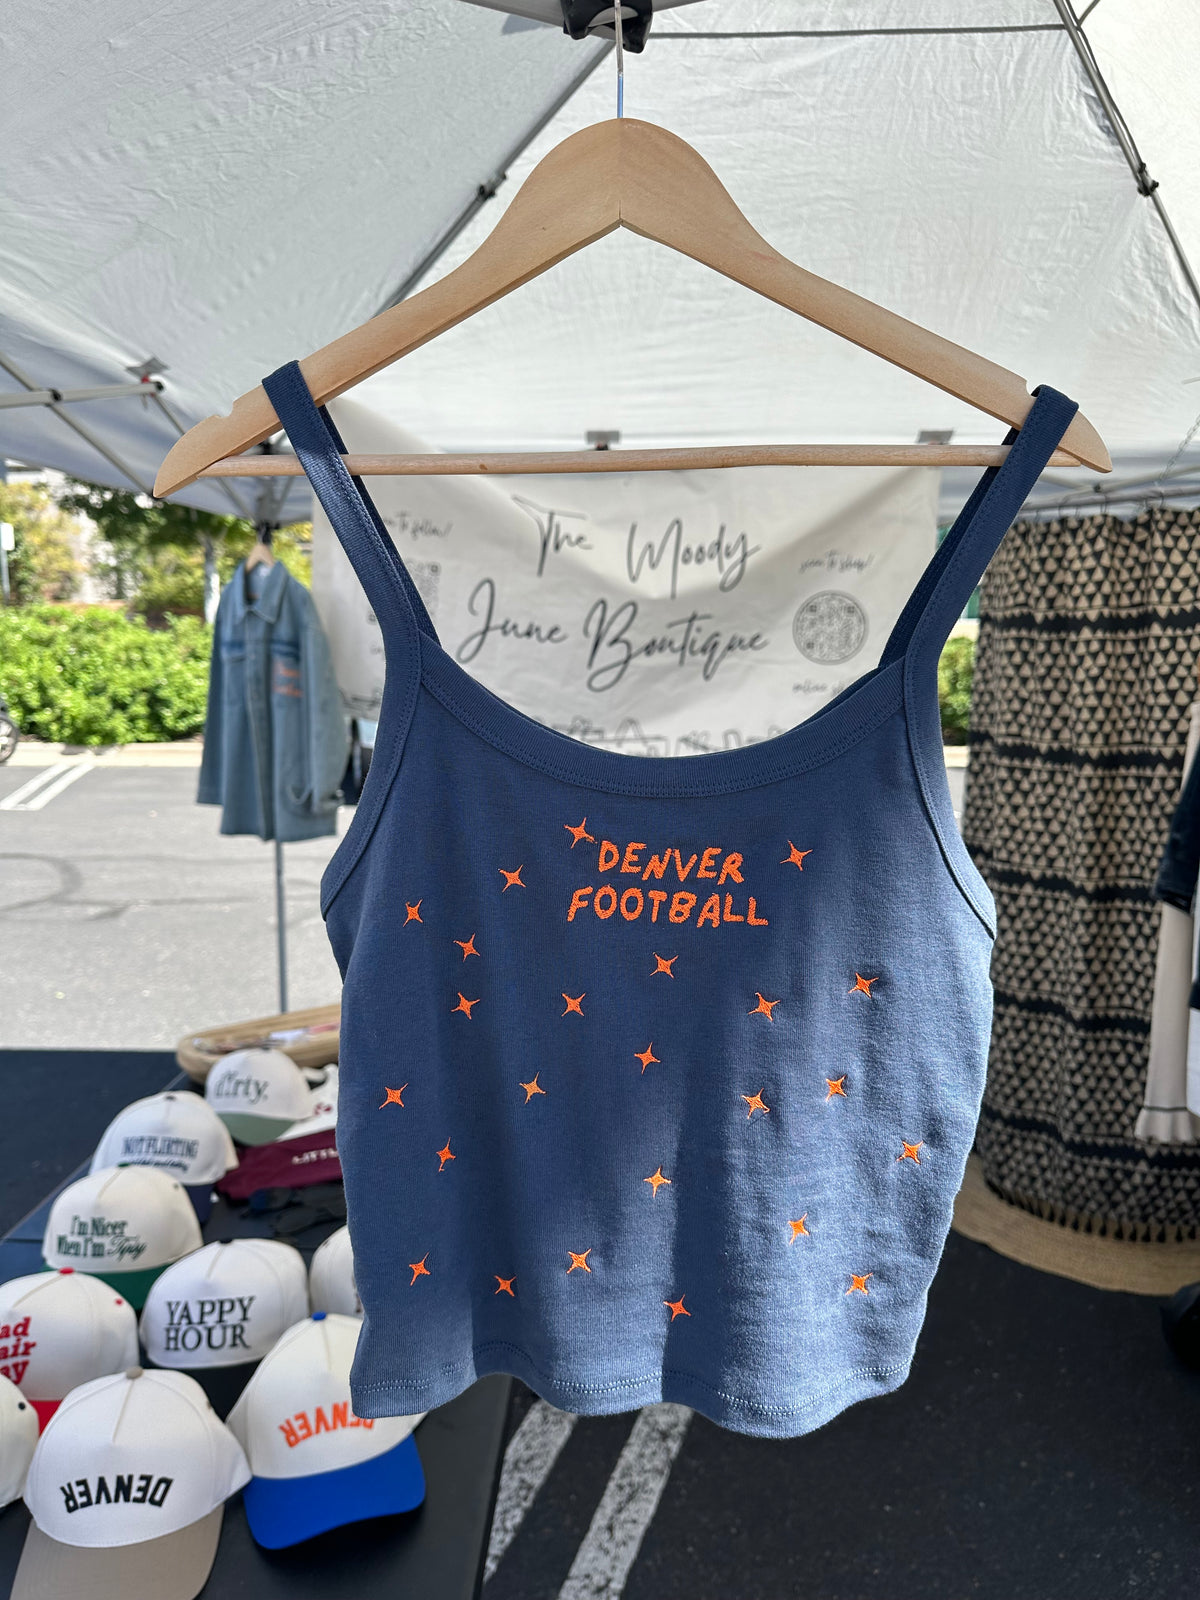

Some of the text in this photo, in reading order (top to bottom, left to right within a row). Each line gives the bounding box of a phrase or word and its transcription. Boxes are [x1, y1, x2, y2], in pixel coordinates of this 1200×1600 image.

[510, 495, 761, 600] The Moody
[456, 577, 768, 692] June Boutique
[597, 840, 744, 885] DENVER
[567, 885, 769, 928] FOOTBALL
[122, 1136, 199, 1160] NOT FLIRTING
[91, 1217, 128, 1236] Nicer
[57, 1235, 81, 1256] When
[166, 1295, 255, 1326] YAPPY
[164, 1323, 252, 1351] HOUR
[60, 1474, 175, 1514] DENVER
